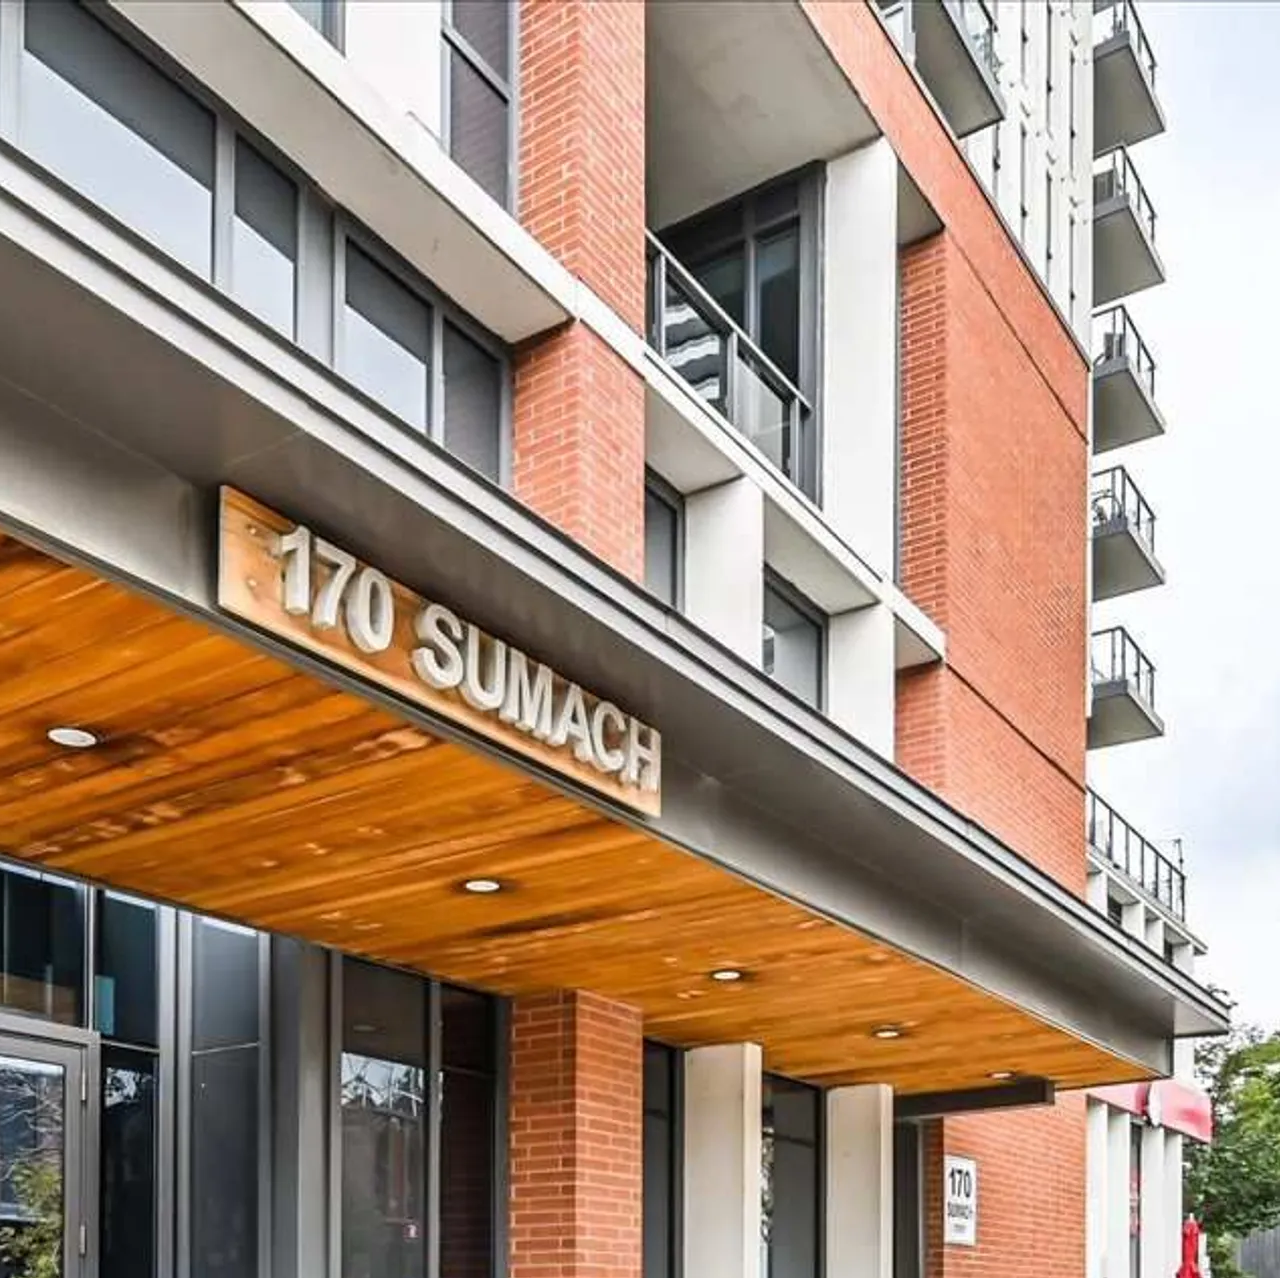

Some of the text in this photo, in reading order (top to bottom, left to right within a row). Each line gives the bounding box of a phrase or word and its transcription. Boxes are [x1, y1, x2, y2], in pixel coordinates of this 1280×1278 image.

[278, 524, 662, 792] 170 SUMACH
[949, 1167, 972, 1198] 170
